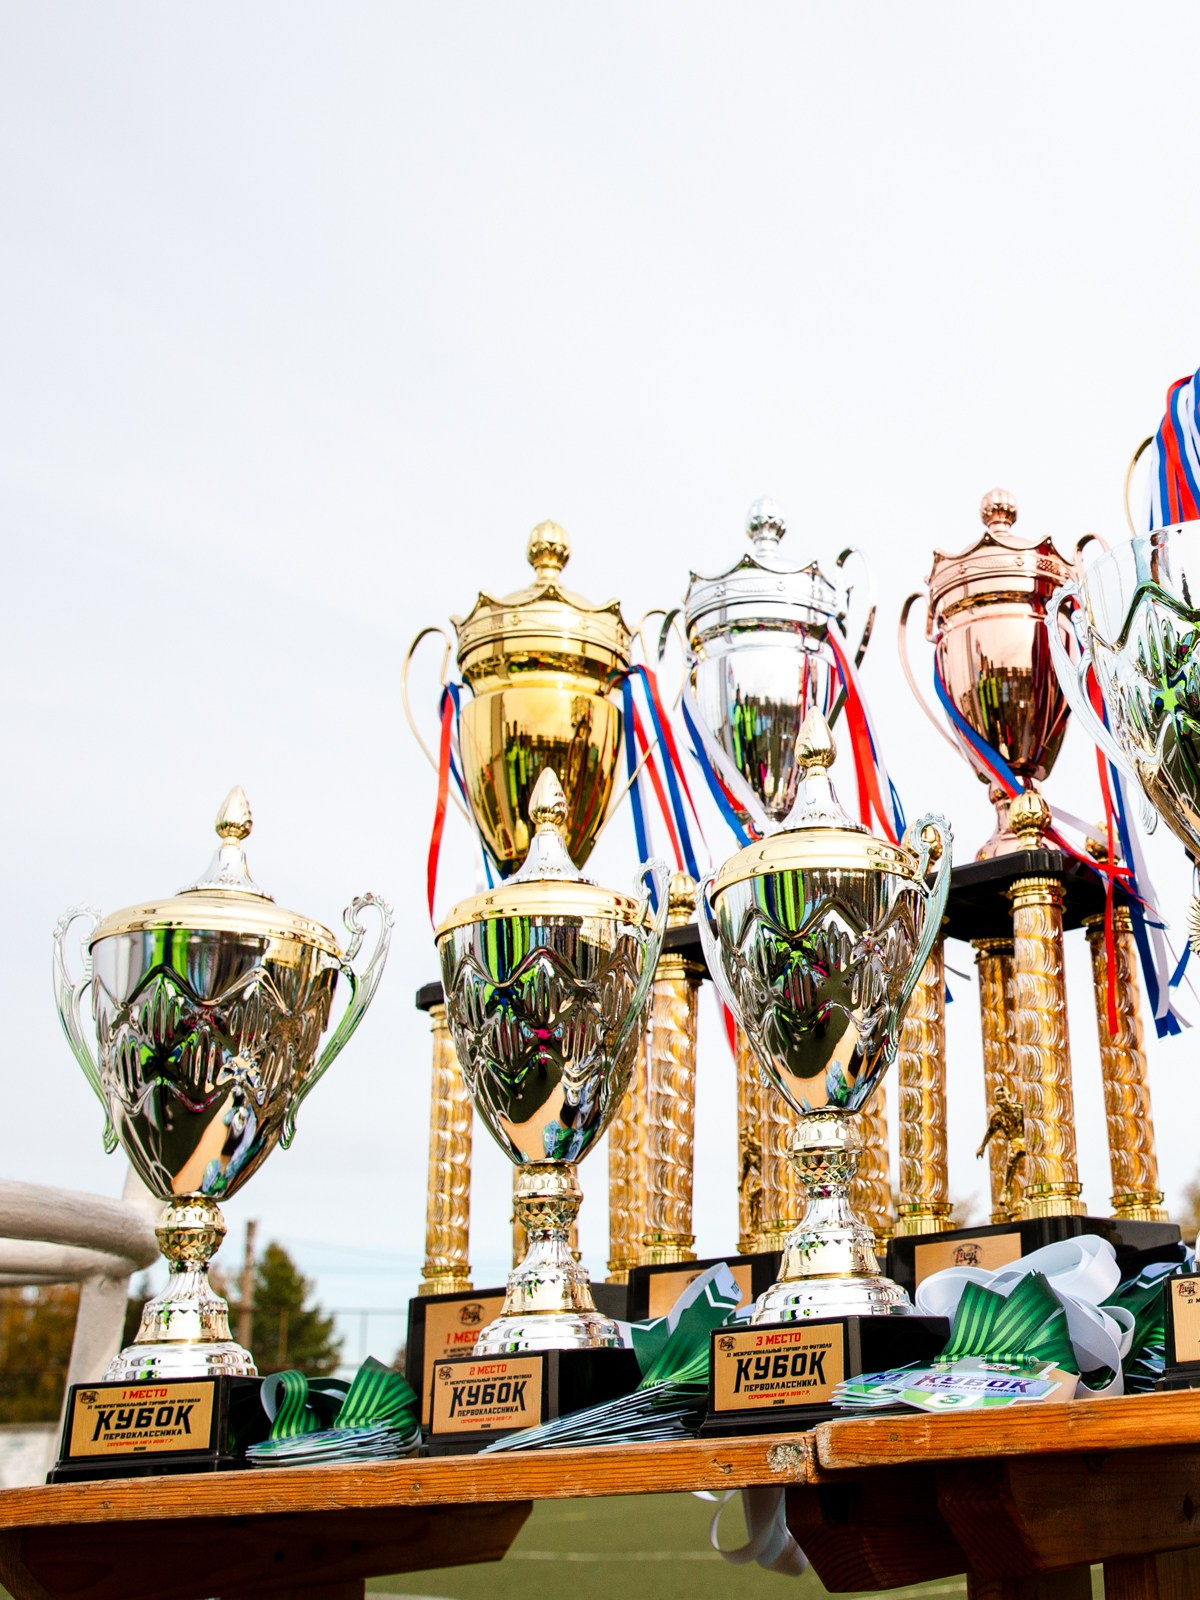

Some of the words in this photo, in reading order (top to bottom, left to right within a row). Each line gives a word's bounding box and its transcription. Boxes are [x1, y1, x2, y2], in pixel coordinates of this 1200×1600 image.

[454, 1330, 480, 1344] МЕС
[756, 1336, 762, 1346] 3
[765, 1332, 801, 1345] МЕСТО
[469, 1366, 475, 1375] 2
[477, 1363, 507, 1375] МЕСТО
[733, 1350, 826, 1393] КУБОК
[744, 1379, 817, 1392] ПЕРВОКЛАССНИКА
[914, 1375, 1033, 1393] КУБОК
[925, 1383, 1017, 1393] ПЕРВОКЛАССНИКА
[122, 1391, 126, 1399] 1
[128, 1388, 168, 1399] МЕСТО
[448, 1380, 527, 1417] КУБОК
[457, 1405, 518, 1416] ПЕРВОКЛАССНИКА
[91, 1404, 194, 1441] КУБОК
[103, 1428, 182, 1440] ПЕРВОКЛАССНИКА
